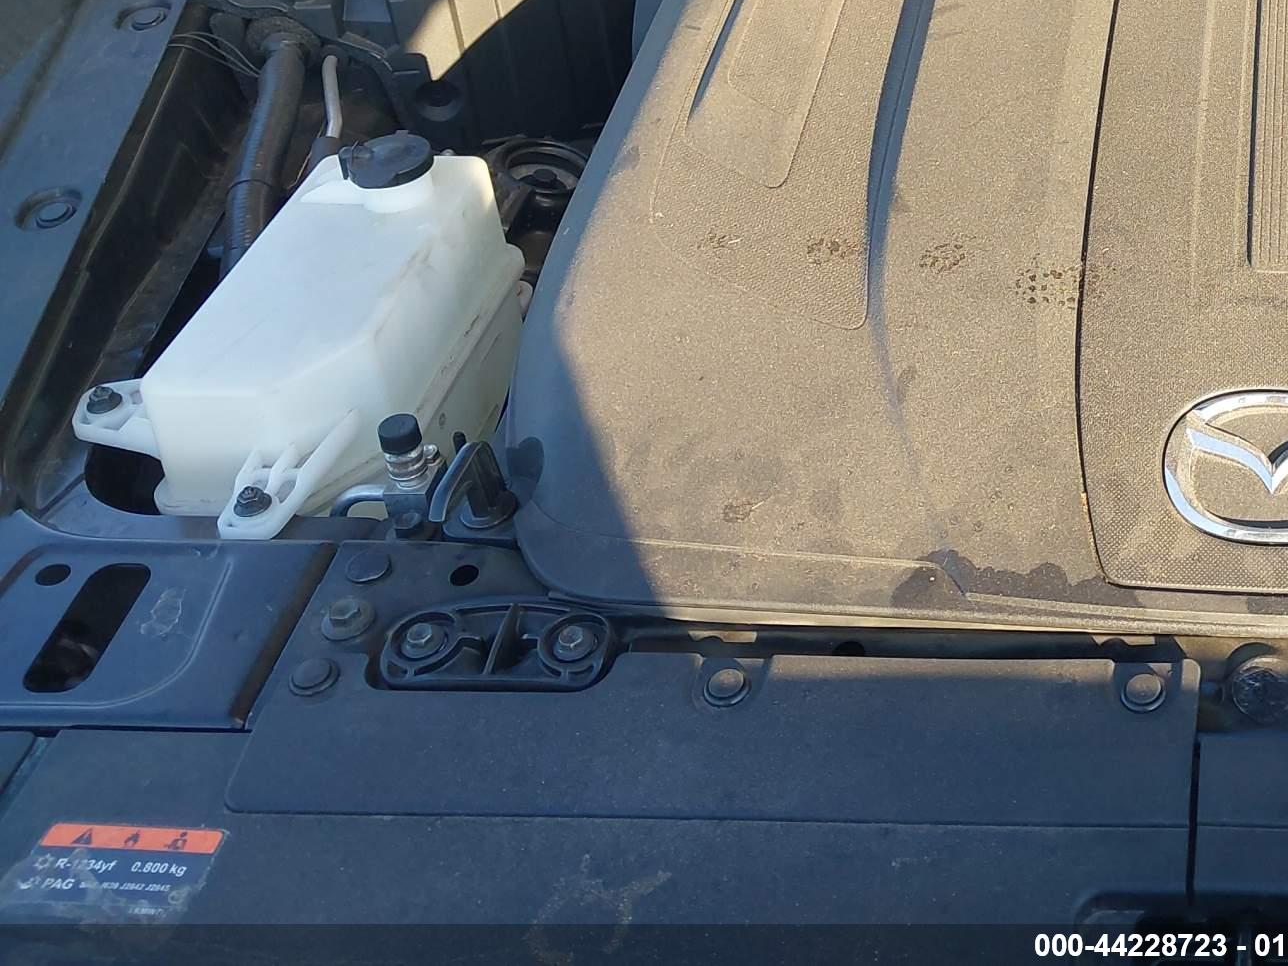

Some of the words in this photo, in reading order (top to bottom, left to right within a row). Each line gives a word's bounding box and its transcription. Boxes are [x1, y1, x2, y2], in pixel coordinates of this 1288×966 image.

[131, 861, 168, 874] 0.800
[169, 863, 187, 877] kg
[40, 878, 76, 890] PAG
